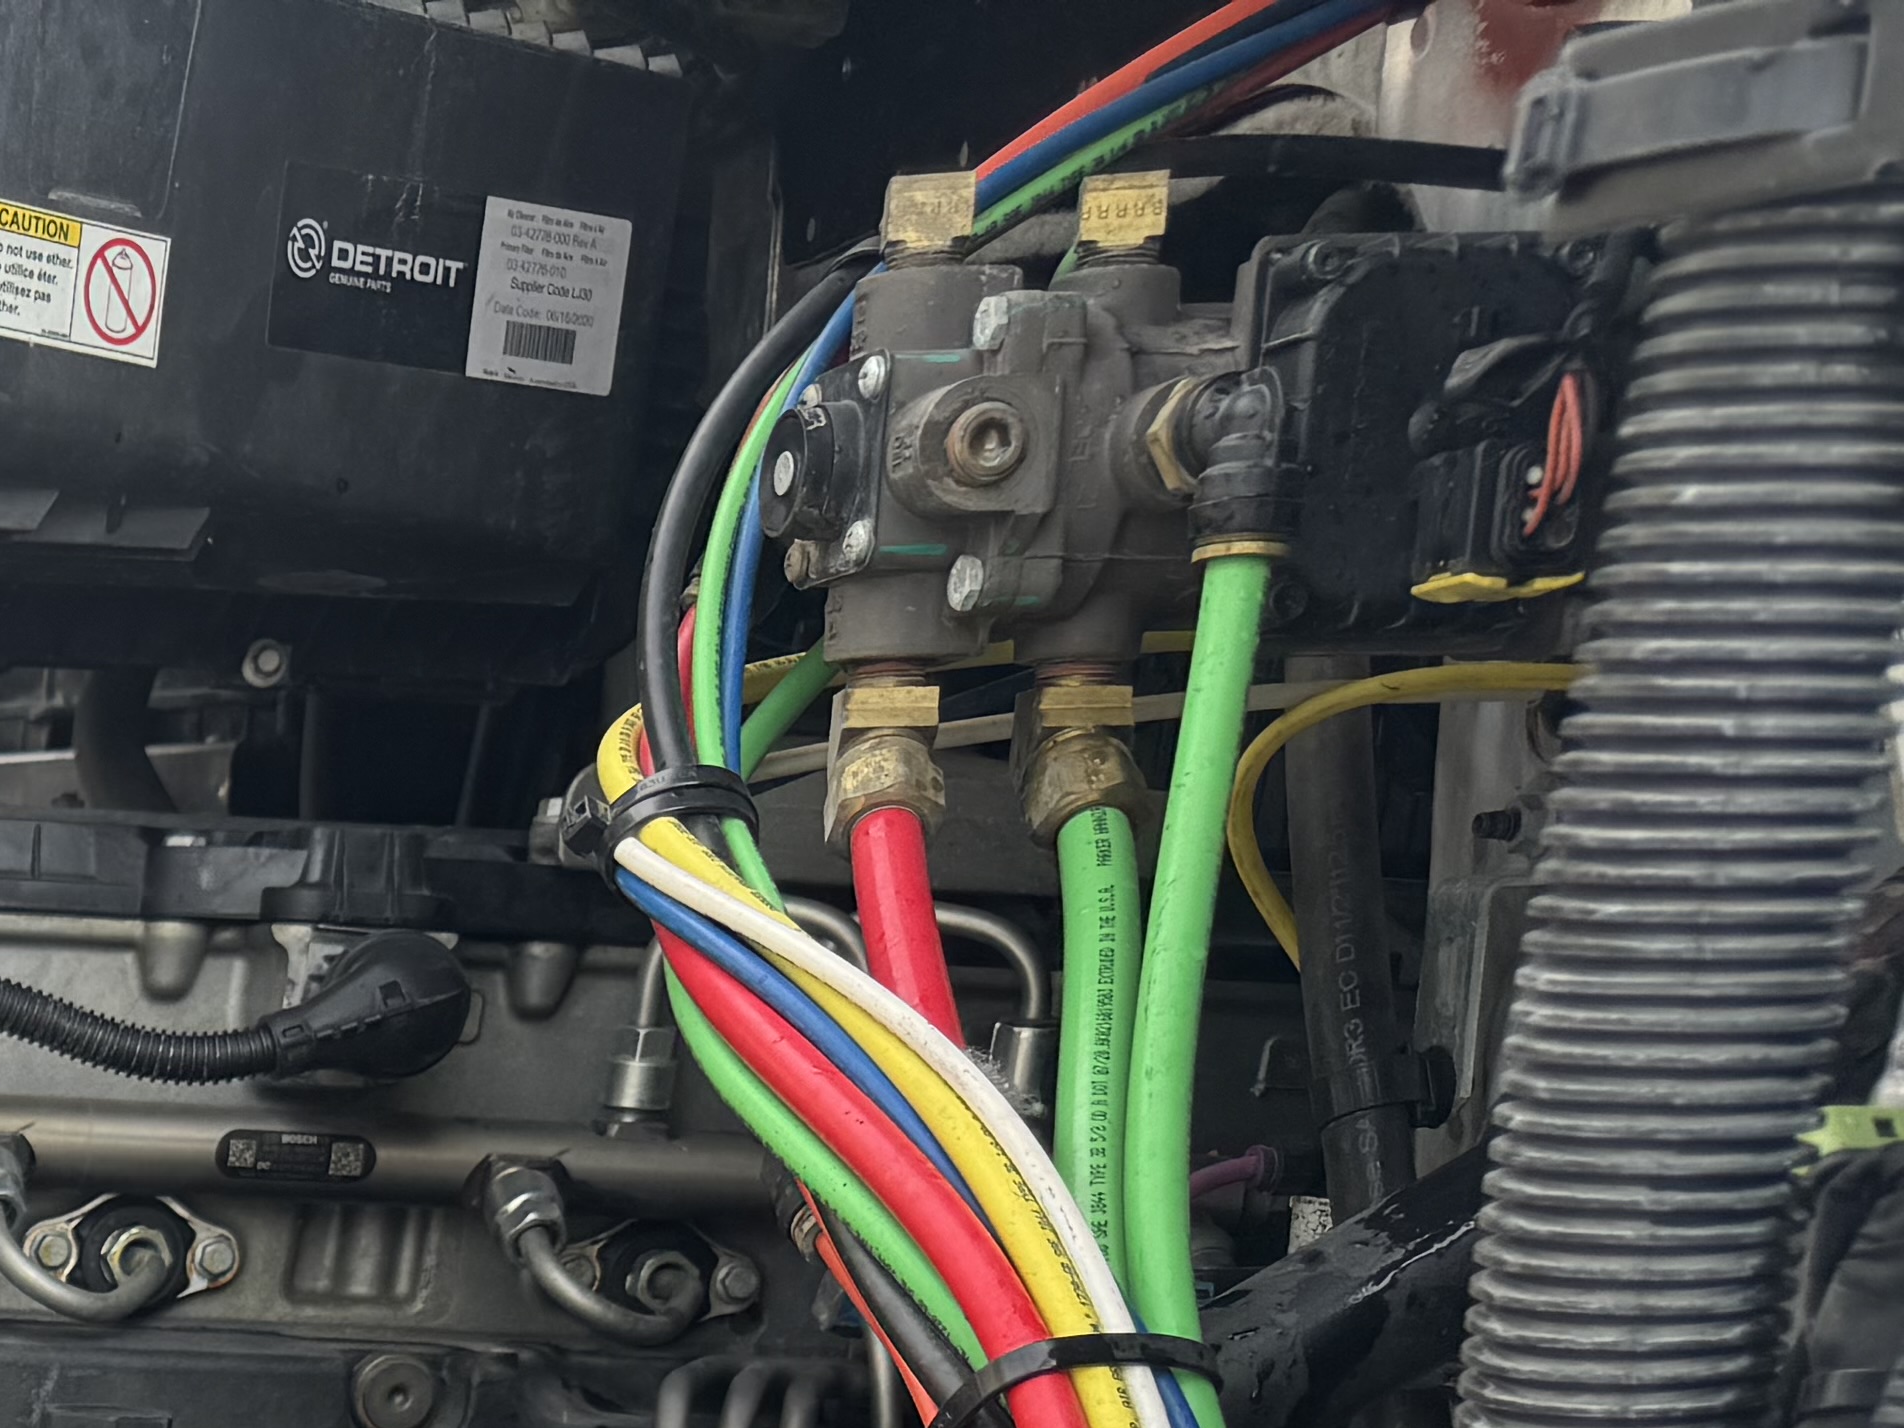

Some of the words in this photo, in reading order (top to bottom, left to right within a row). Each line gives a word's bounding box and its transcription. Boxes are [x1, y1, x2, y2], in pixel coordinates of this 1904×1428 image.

[0, 208, 69, 242] CAUTION
[6, 245, 22, 258] not
[26, 252, 42, 262] use
[47, 253, 73, 269] ether.
[331, 239, 463, 287] DETROIT
[329, 272, 365, 289] GENUINE
[367, 278, 391, 293] PARTS
[510, 276, 544, 293] Supplier
[547, 283, 569, 297] Code
[34, 290, 51, 303] pas
[494, 301, 514, 315] Date
[1093, 837, 1111, 866] PARKER
[1099, 915, 1115, 929] THE
[1099, 932, 1115, 942] IN
[1097, 946, 1116, 984] EXTRUDED
[1338, 969, 1360, 1007] EC
[1091, 1080, 1108, 1095] DOT
[282, 1134, 317, 1144] BOSCH
[1088, 1164, 1106, 1185] TYPE
[1117, 1387, 1134, 1407] AIR
